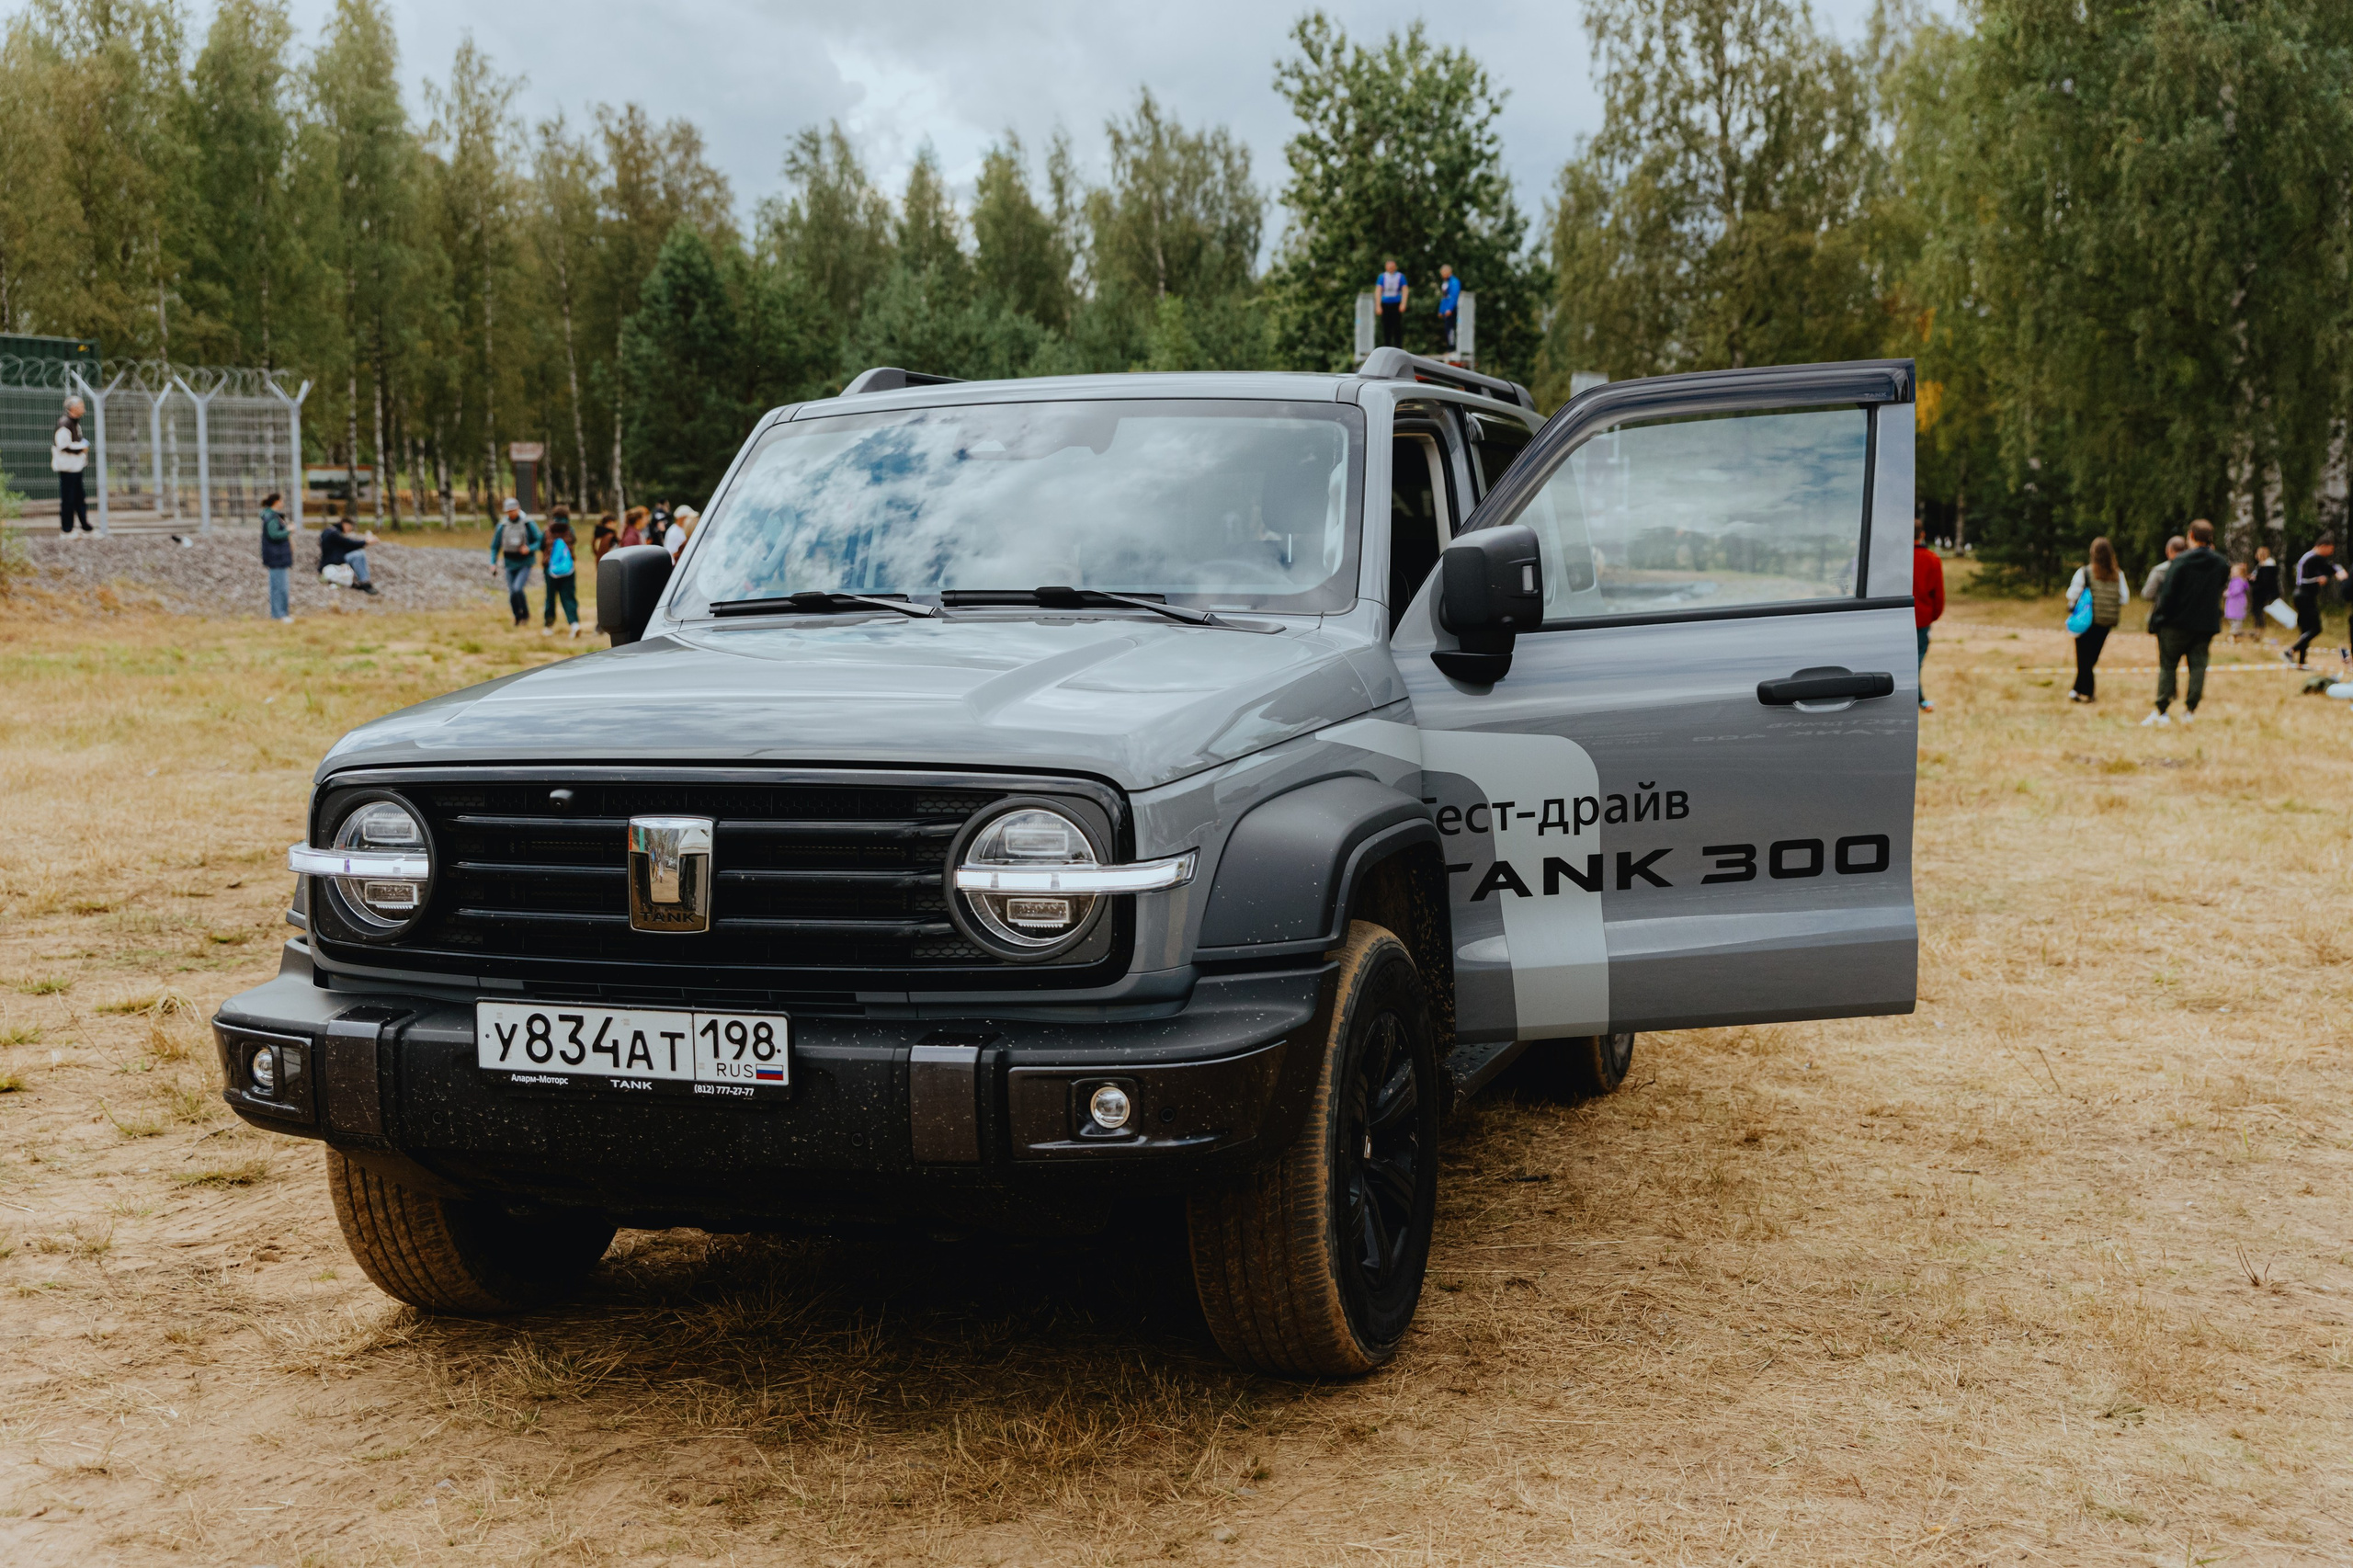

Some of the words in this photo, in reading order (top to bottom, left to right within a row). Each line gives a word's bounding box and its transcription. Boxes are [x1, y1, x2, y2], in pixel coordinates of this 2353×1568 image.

[1422, 781, 1690, 836] ест-драйв
[1700, 834, 1890, 885] 300
[640, 911, 695, 924] TANK
[699, 1018, 776, 1062] 198
[716, 1062, 754, 1078] RUS
[511, 1074, 569, 1085] Аларм-Моторс
[610, 1079, 653, 1091] TANK
[694, 1084, 715, 1095] (812)
[717, 1085, 755, 1096] 777-27-77
